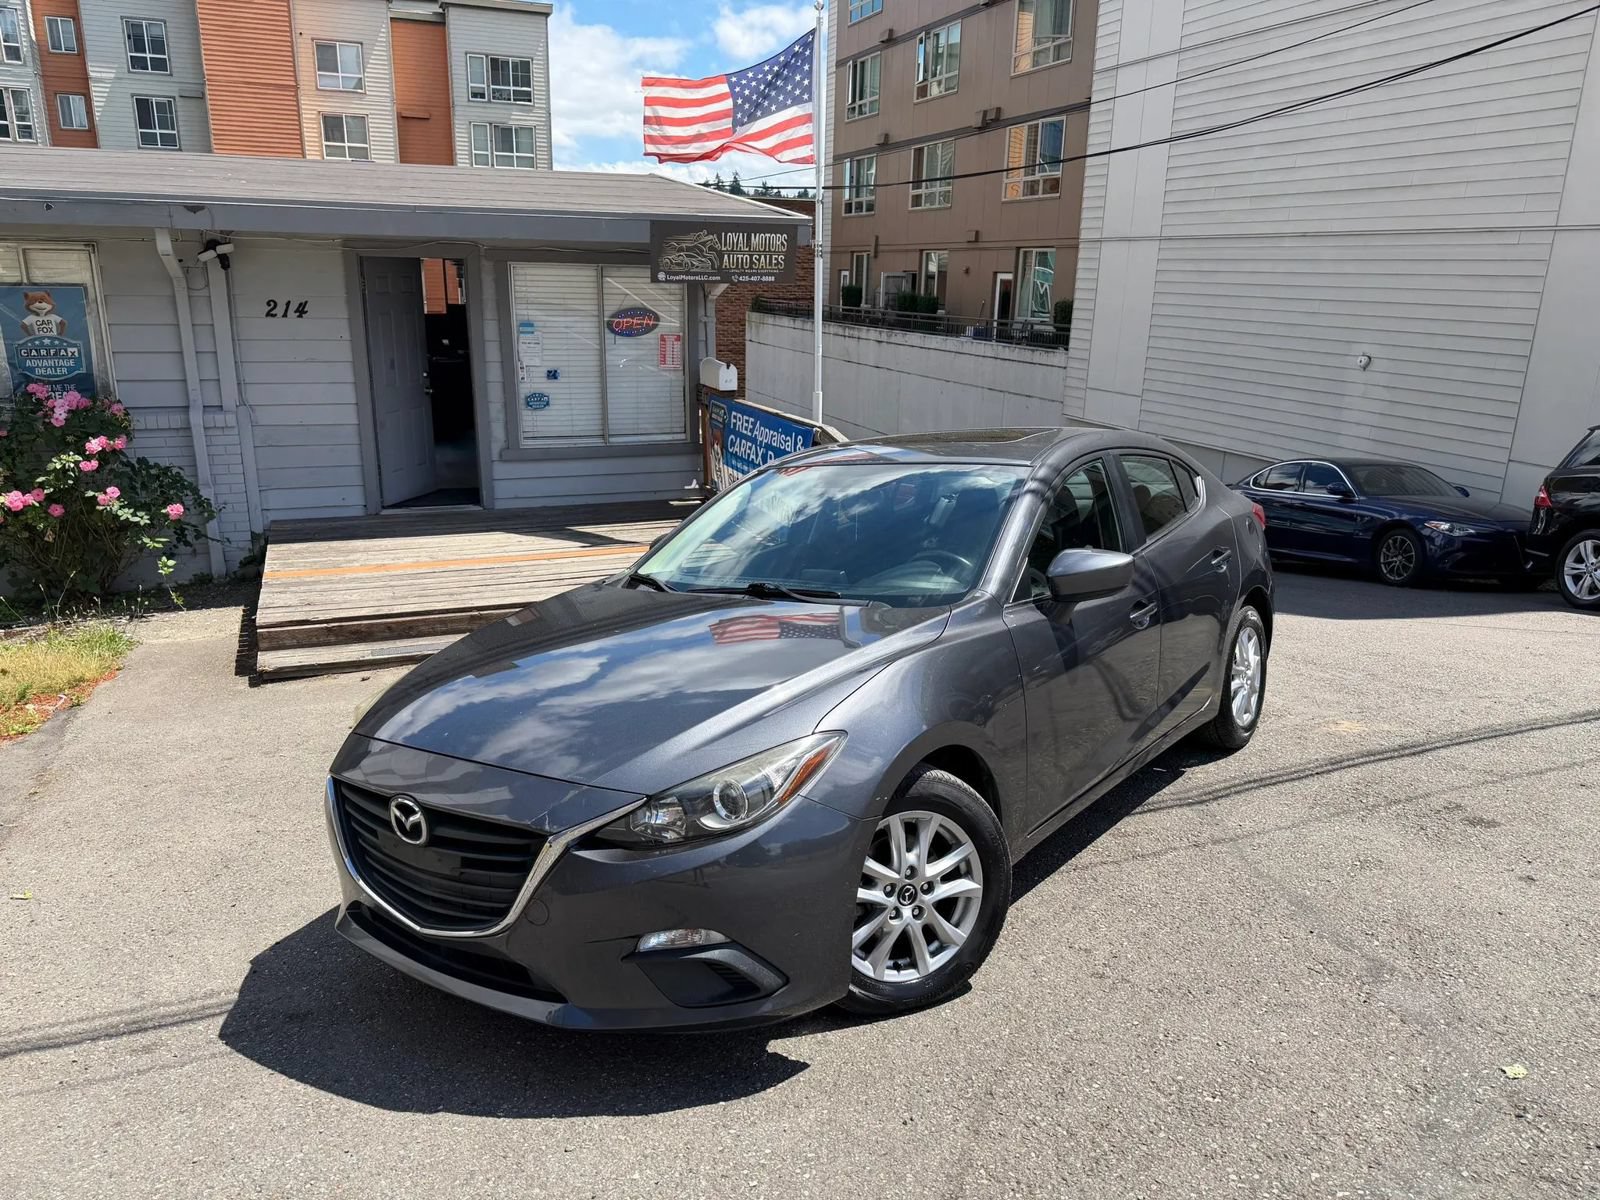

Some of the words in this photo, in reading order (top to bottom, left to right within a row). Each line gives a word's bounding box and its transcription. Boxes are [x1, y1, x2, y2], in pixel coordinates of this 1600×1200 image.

[721, 232, 749, 251] LOYAL
[751, 233, 788, 252] MOTORS
[722, 254, 749, 269] AUTO
[752, 255, 785, 269] SALES
[666, 274, 721, 282] LoyalMotorsLLC.com
[265, 299, 308, 318] 214
[35, 319, 53, 327] CAR
[613, 315, 655, 330] OPEN
[37, 326, 54, 334] FOX
[21, 348, 78, 357] CARFAX
[26, 359, 76, 367] ADVANTAGE
[35, 367, 68, 375] DEALER
[64, 383, 77, 391] THE
[731, 411, 754, 436] FREE
[752, 420, 795, 453] Appraisal
[796, 435, 804, 452] &
[727, 435, 764, 467] CARFAX
